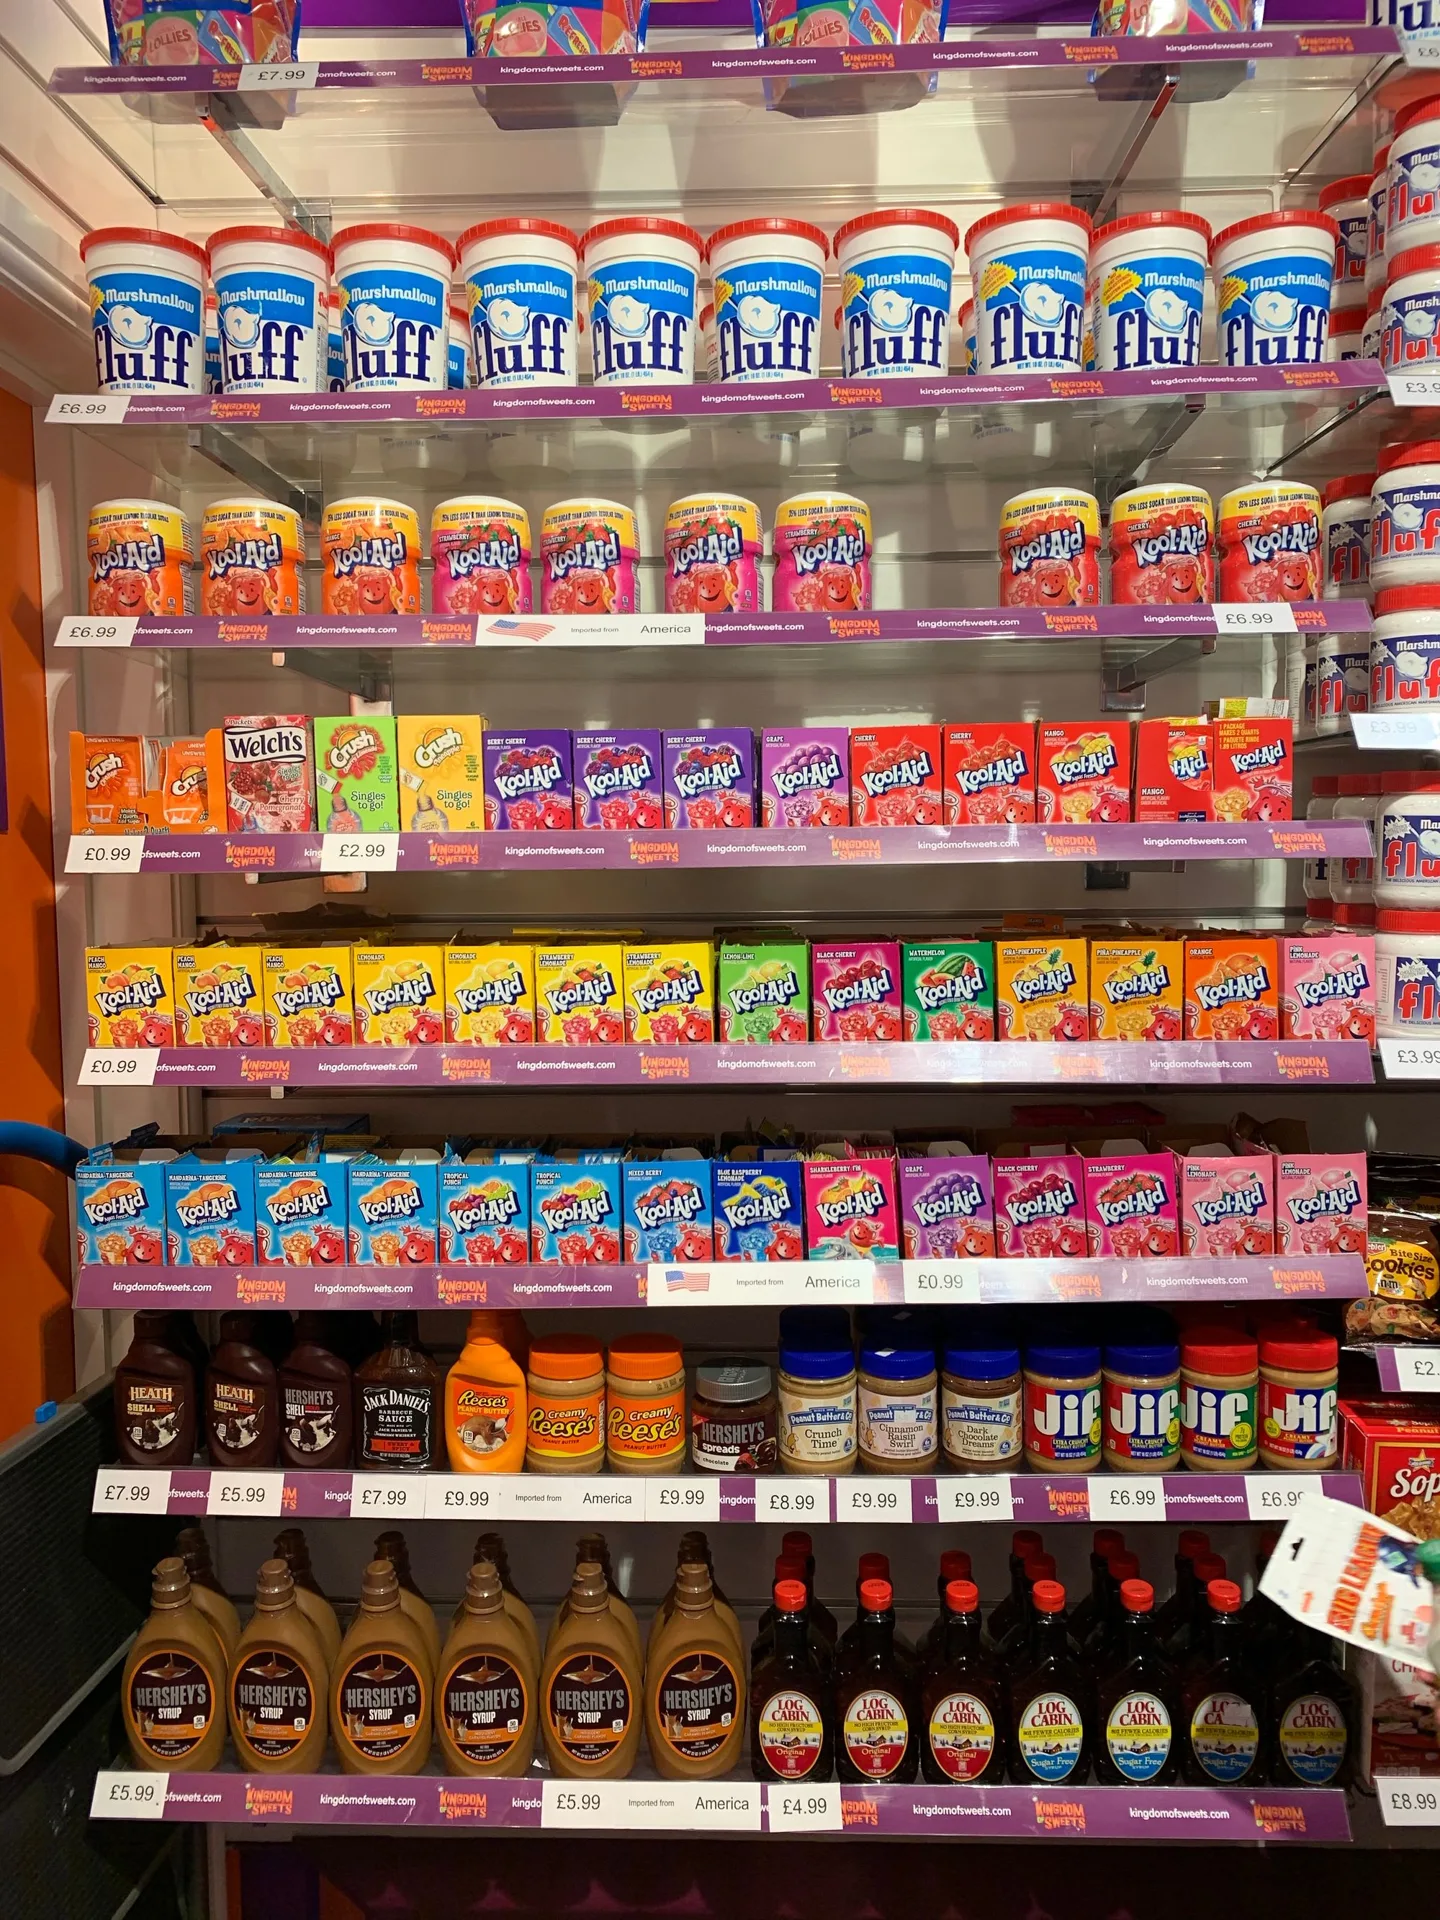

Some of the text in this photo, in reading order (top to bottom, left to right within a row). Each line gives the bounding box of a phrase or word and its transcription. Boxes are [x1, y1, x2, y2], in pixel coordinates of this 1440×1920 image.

[933, 50, 1038, 60] kingdomofsweets.com
[258, 70, 305, 81] £7.99
[500, 65, 604, 74] kingdomofsweets.com
[867, 270, 947, 291] Marshmallow
[484, 280, 567, 298] Marshmallow
[606, 278, 688, 297] Marshmallow
[721, 313, 815, 381] fluff
[848, 306, 944, 378] fluff
[474, 313, 567, 386] fluff
[831, 387, 881, 396] KINGDOM
[920, 384, 1024, 394] kingdomofsweets.com
[493, 397, 595, 406] kingdomofsweets.com
[840, 395, 882, 405] SWEETS
[58, 403, 106, 414] £6.99
[1237, 518, 1262, 528] CHERRY
[438, 533, 469, 542] STRAWBERRY
[785, 529, 817, 538] STRAWBERRY
[1243, 517, 1319, 564] Kool-Aid
[447, 535, 521, 577] Kool-Aid
[793, 529, 865, 574] Kool-Aid
[1226, 613, 1272, 624] £6.99
[70, 626, 116, 637] £6.99
[640, 624, 691, 634] America
[229, 732, 303, 757] Welch's
[330, 730, 375, 767] Crush
[415, 725, 464, 767] Crush
[494, 756, 564, 799] Kool-Aid
[279, 795, 305, 803] Cherry
[437, 790, 472, 800] Singles
[444, 799, 470, 809] to go!
[85, 848, 130, 860] £0.99
[339, 844, 385, 856] £2.99
[505, 846, 604, 855] kingdomofsweets.com
[94, 974, 163, 1017] Kool-Aid
[916, 969, 984, 1013] Kool-Aid
[91, 1060, 136, 1073] £0.99
[517, 1060, 615, 1069] kingdomofsweets.com
[1088, 1165, 1125, 1173] STRAWBERRY
[724, 1187, 791, 1229] Kool-Aid
[1390, 1249, 1433, 1263] Bite Size
[113, 1282, 211, 1292] kingdomofsweets.com
[237, 1279, 286, 1291] KINGDOM
[805, 1276, 860, 1288] America
[918, 1275, 963, 1289] £0.99
[243, 1291, 285, 1303] SWEETS
[130, 1387, 172, 1402] HEATH
[285, 1389, 333, 1404] HERSHEY'S
[364, 1390, 431, 1413] JACK DANIEL'S
[127, 1404, 155, 1413] SHELL
[286, 1404, 305, 1416] SHELL
[548, 1409, 588, 1419] Creamy
[1181, 1387, 1248, 1435] Jif
[702, 1423, 765, 1443] HERSHEY'S
[805, 1429, 842, 1439] Crunch
[880, 1424, 923, 1433] Cinnamon
[967, 1426, 988, 1434] Dark
[959, 1431, 998, 1441] Chocolate
[1196, 1435, 1222, 1444] CREAMY
[702, 1443, 740, 1454] spreads
[811, 1440, 837, 1448] Time
[962, 1439, 994, 1448] Dreams
[703, 1457, 729, 1466] chocolate
[105, 1486, 150, 1500] £7.99
[221, 1488, 265, 1501] £5.99
[362, 1490, 407, 1505] £7.99
[445, 1491, 489, 1505] £9.99
[516, 1494, 547, 1502] Imported
[583, 1493, 632, 1504] America
[660, 1490, 704, 1504] £9.99
[955, 1492, 1000, 1506] £9.99
[1110, 1490, 1155, 1505] £6.99
[770, 1495, 814, 1509] £8.99
[852, 1493, 897, 1508] £9.99
[136, 1684, 206, 1706] HERSHEY'S
[778, 1699, 803, 1710] LOG
[1038, 1702, 1065, 1713] LOG
[158, 1708, 181, 1719] SYRUP
[772, 1710, 810, 1721] CABIN
[1031, 1713, 1073, 1726] CABIN
[776, 1749, 805, 1757] Original
[1031, 1757, 1074, 1768] Sugar Free
[111, 1785, 154, 1801] £5.99
[246, 1788, 292, 1802] KINGDOM
[320, 1795, 416, 1805] kingdomofsweets.com
[557, 1795, 601, 1809] £5.99
[695, 1796, 749, 1810] America
[783, 1798, 827, 1814] £4.99
[1392, 1794, 1436, 1810] £8.99
[252, 1802, 292, 1815] SWEETS
[913, 1805, 1011, 1816] kingdomofsweets.com
[1130, 1808, 1229, 1819] kingdomofsweets.com
